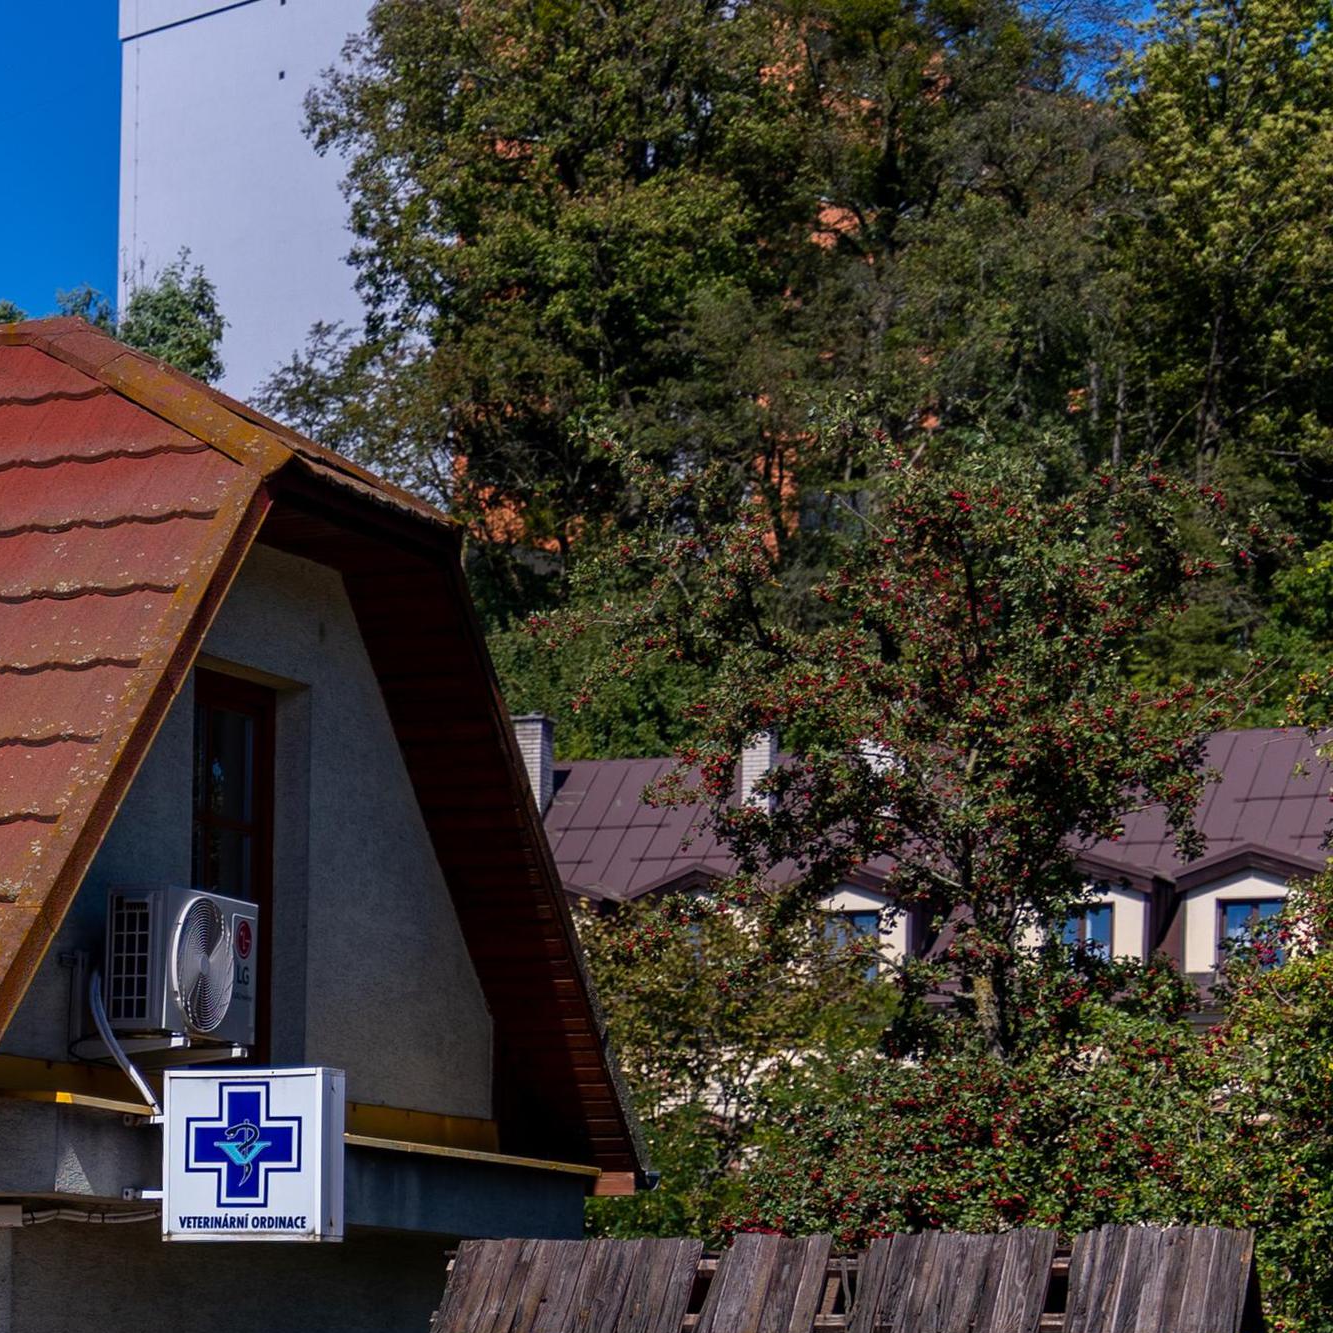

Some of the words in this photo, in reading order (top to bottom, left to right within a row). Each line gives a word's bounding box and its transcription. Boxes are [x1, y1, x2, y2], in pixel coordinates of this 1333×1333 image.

[236, 964, 250, 985] LG
[179, 1213, 249, 1230] VETERINÁRNÍ
[251, 1214, 307, 1229] ORDINACE
